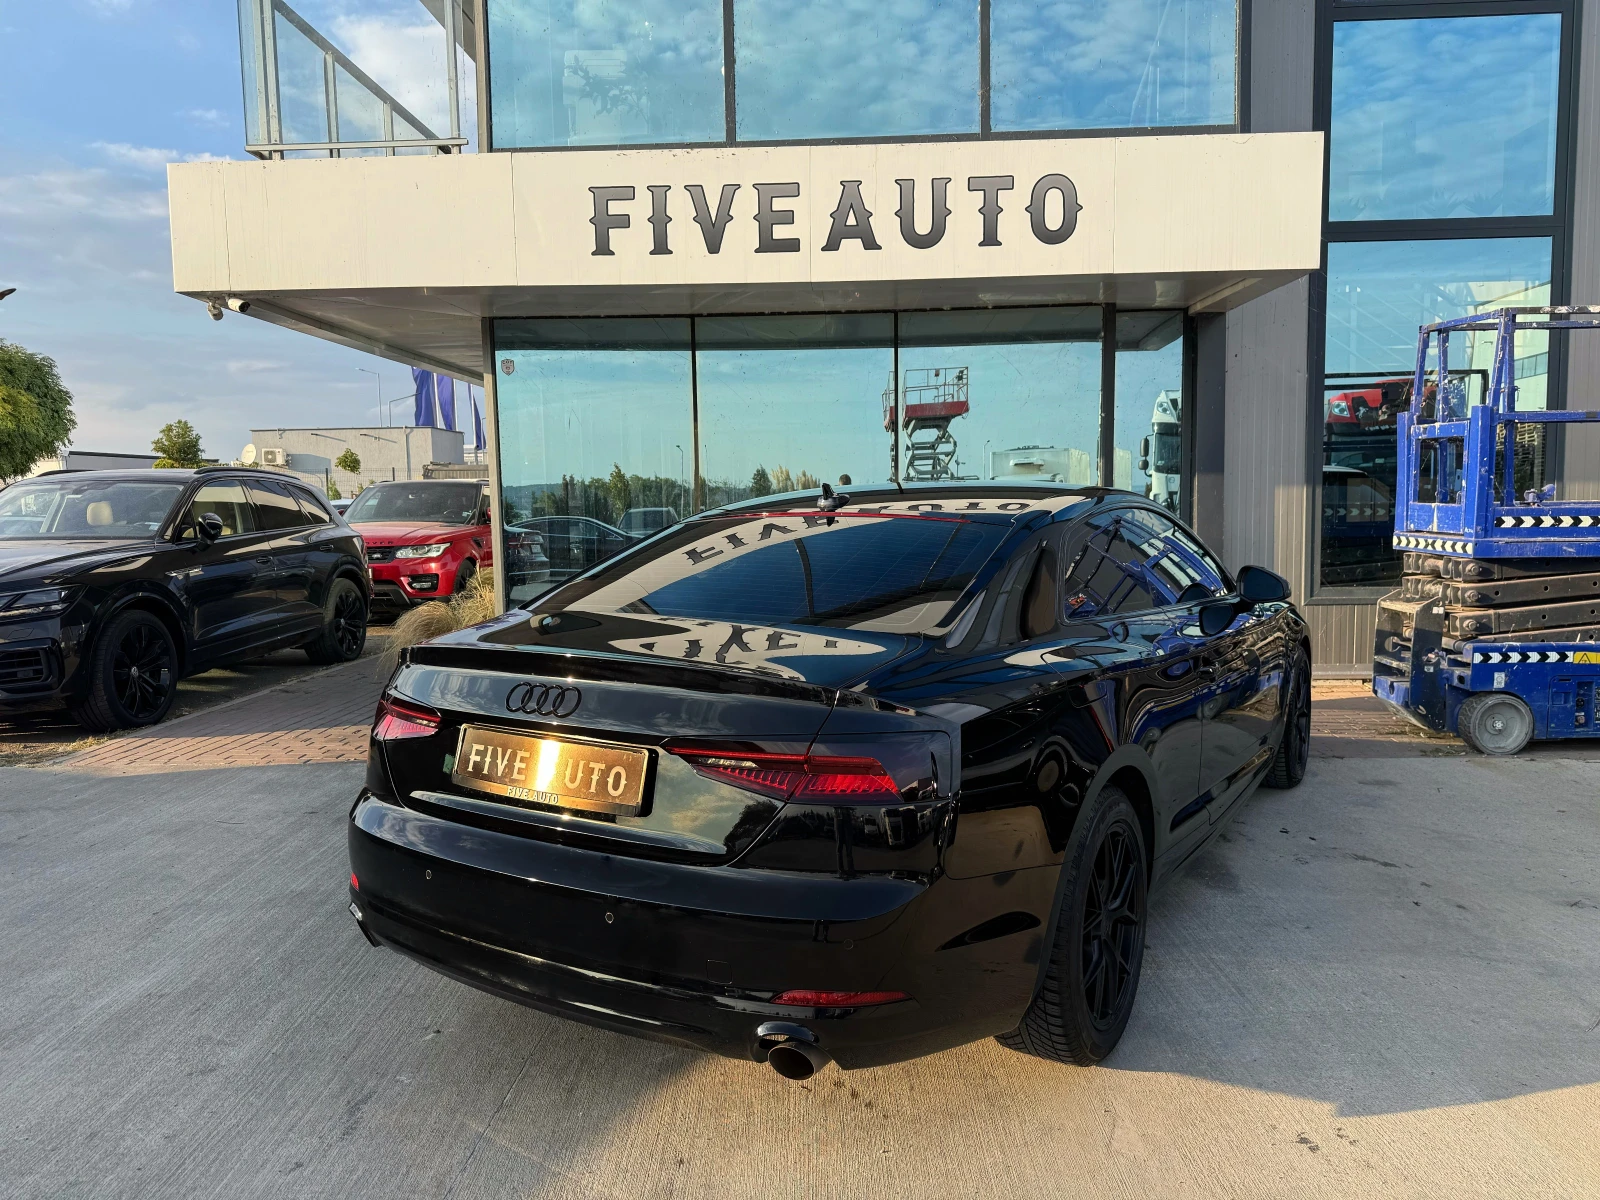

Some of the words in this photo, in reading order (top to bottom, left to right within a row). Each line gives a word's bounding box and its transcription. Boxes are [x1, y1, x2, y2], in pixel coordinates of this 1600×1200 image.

[588, 182, 800, 256] FIVE
[820, 173, 1083, 251] AUTO
[467, 743, 531, 780] FIVE
[548, 755, 628, 797] UTO
[507, 786, 530, 799] FIVE
[532, 790, 559, 804] AUTO
